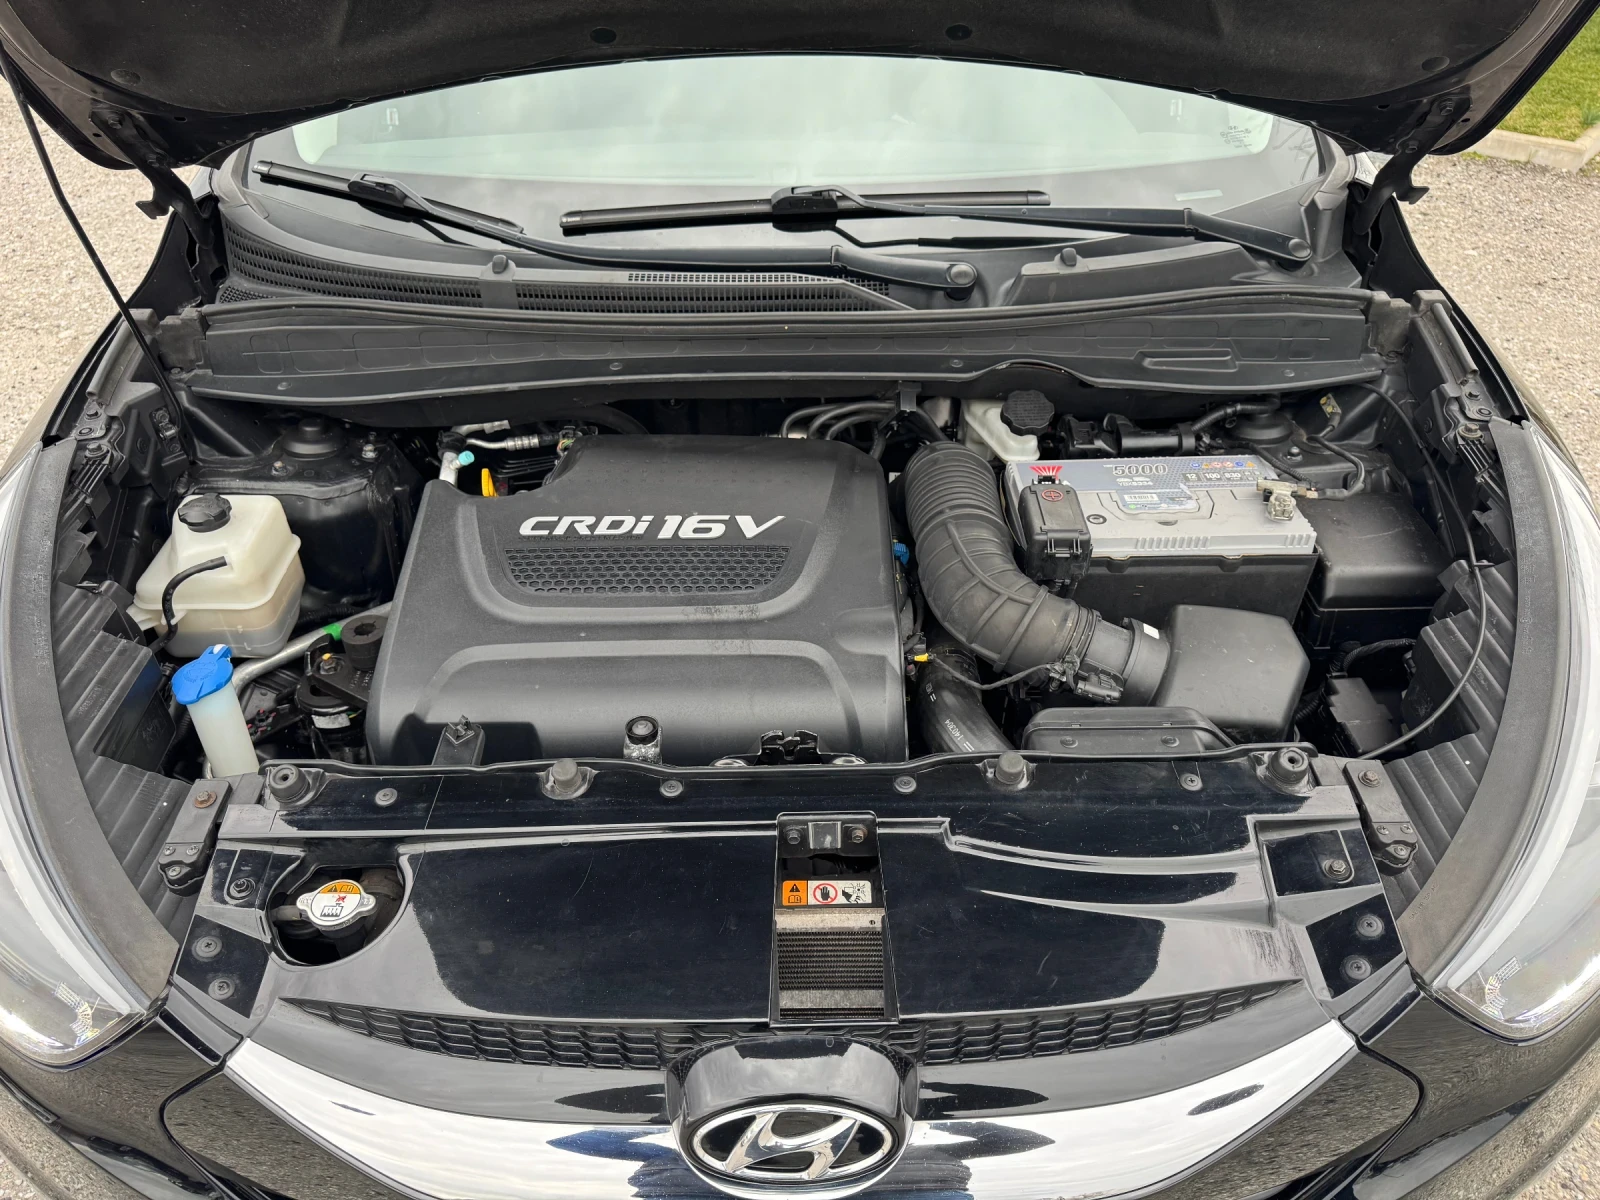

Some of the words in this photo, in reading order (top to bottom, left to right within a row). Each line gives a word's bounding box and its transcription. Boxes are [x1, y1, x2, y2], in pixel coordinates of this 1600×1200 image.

[1112, 463, 1168, 476] 5000
[519, 516, 655, 536] CRDi
[945, 719, 964, 740] 140304
